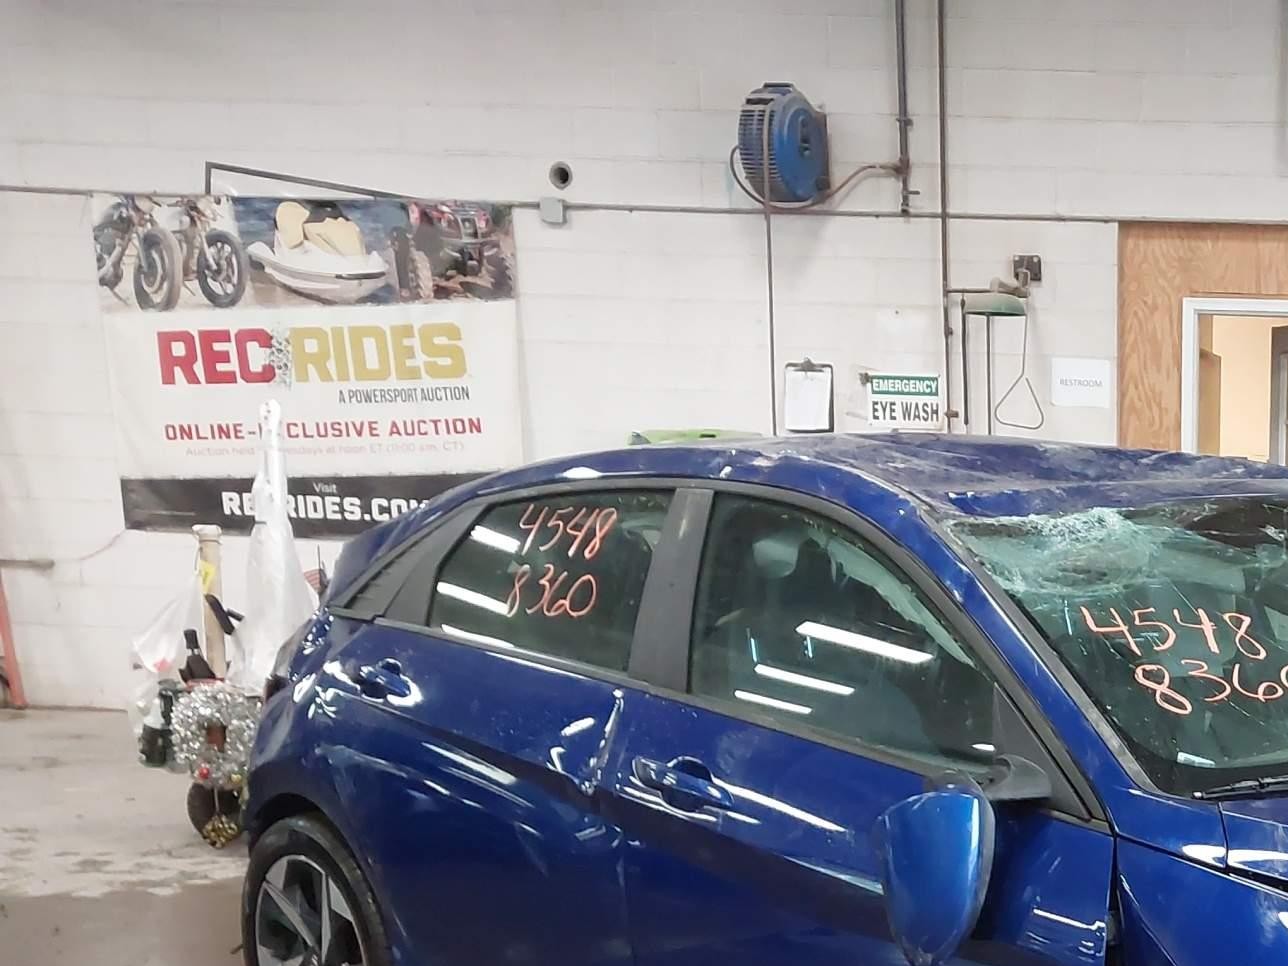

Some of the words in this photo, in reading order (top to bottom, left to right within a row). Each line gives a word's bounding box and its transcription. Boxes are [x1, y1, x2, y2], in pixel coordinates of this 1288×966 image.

[157, 328, 276, 385] REC
[289, 322, 468, 382] RIDES
[338, 389, 347, 404] A
[349, 387, 418, 403] POWERSPORT
[420, 385, 470, 401] AUCTION
[872, 378, 937, 393] EMERGENCY
[872, 401, 897, 421] EYE
[901, 401, 939, 422] WASH
[389, 417, 483, 437] AUCTION
[312, 482, 337, 494] Visit
[519, 503, 617, 560] 4548
[1080, 606, 1267, 661] 4548
